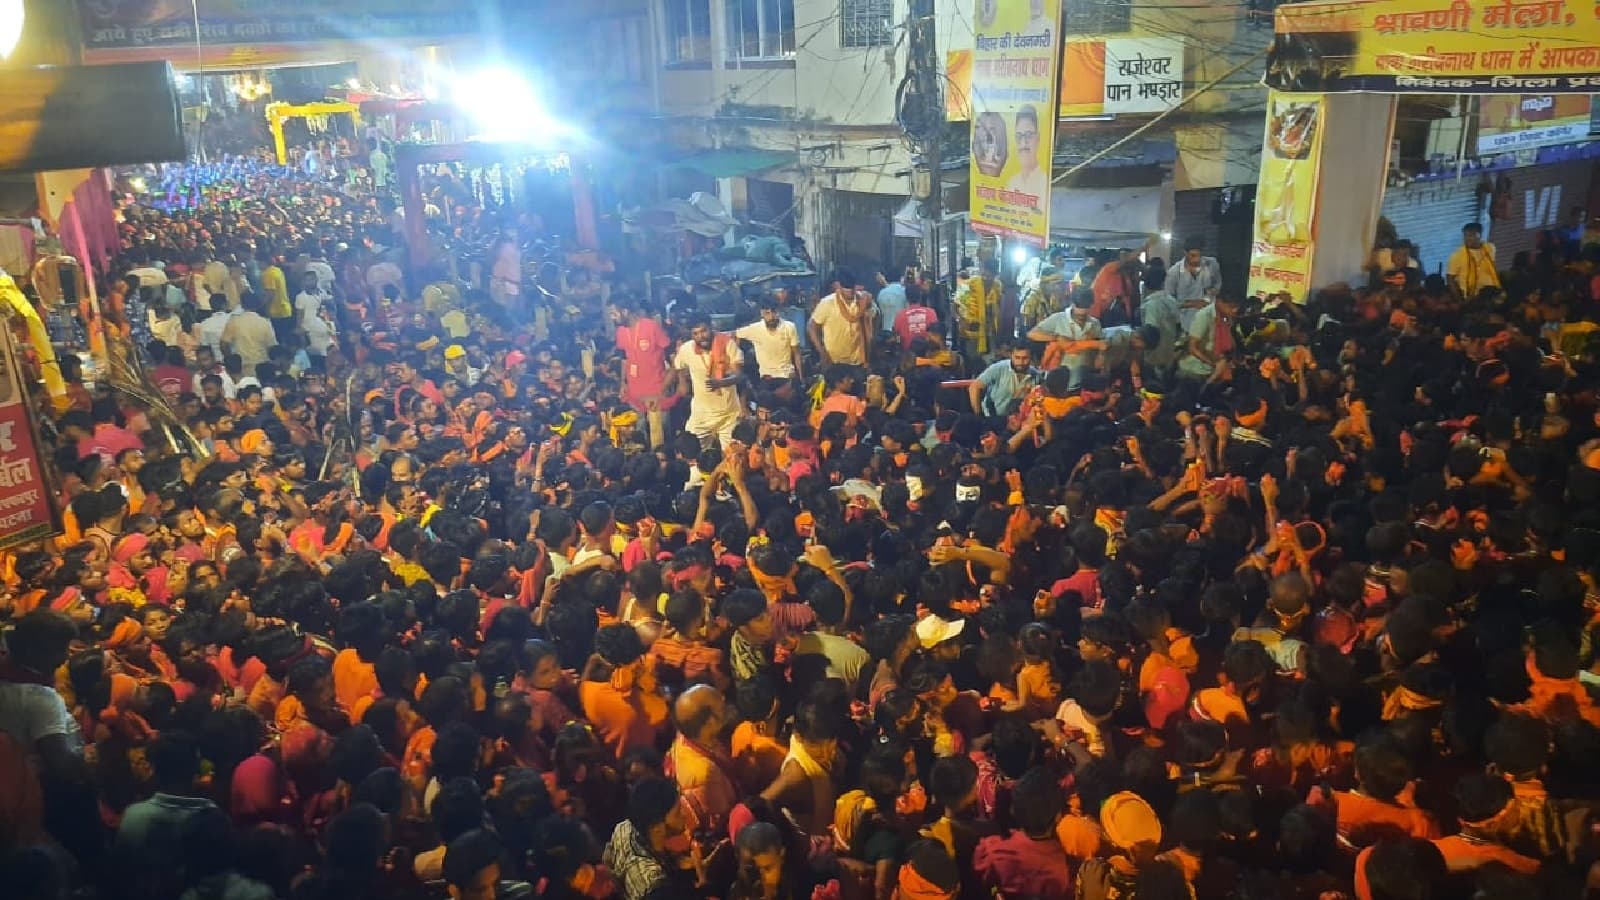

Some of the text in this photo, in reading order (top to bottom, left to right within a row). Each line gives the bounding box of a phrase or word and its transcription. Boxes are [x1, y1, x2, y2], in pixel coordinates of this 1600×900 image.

[1374, 1, 1472, 33] श्रावणी
[1481, 50, 1514, 70] धाम
[1518, 41, 1540, 68] में
[1107, 84, 1131, 101] पान
